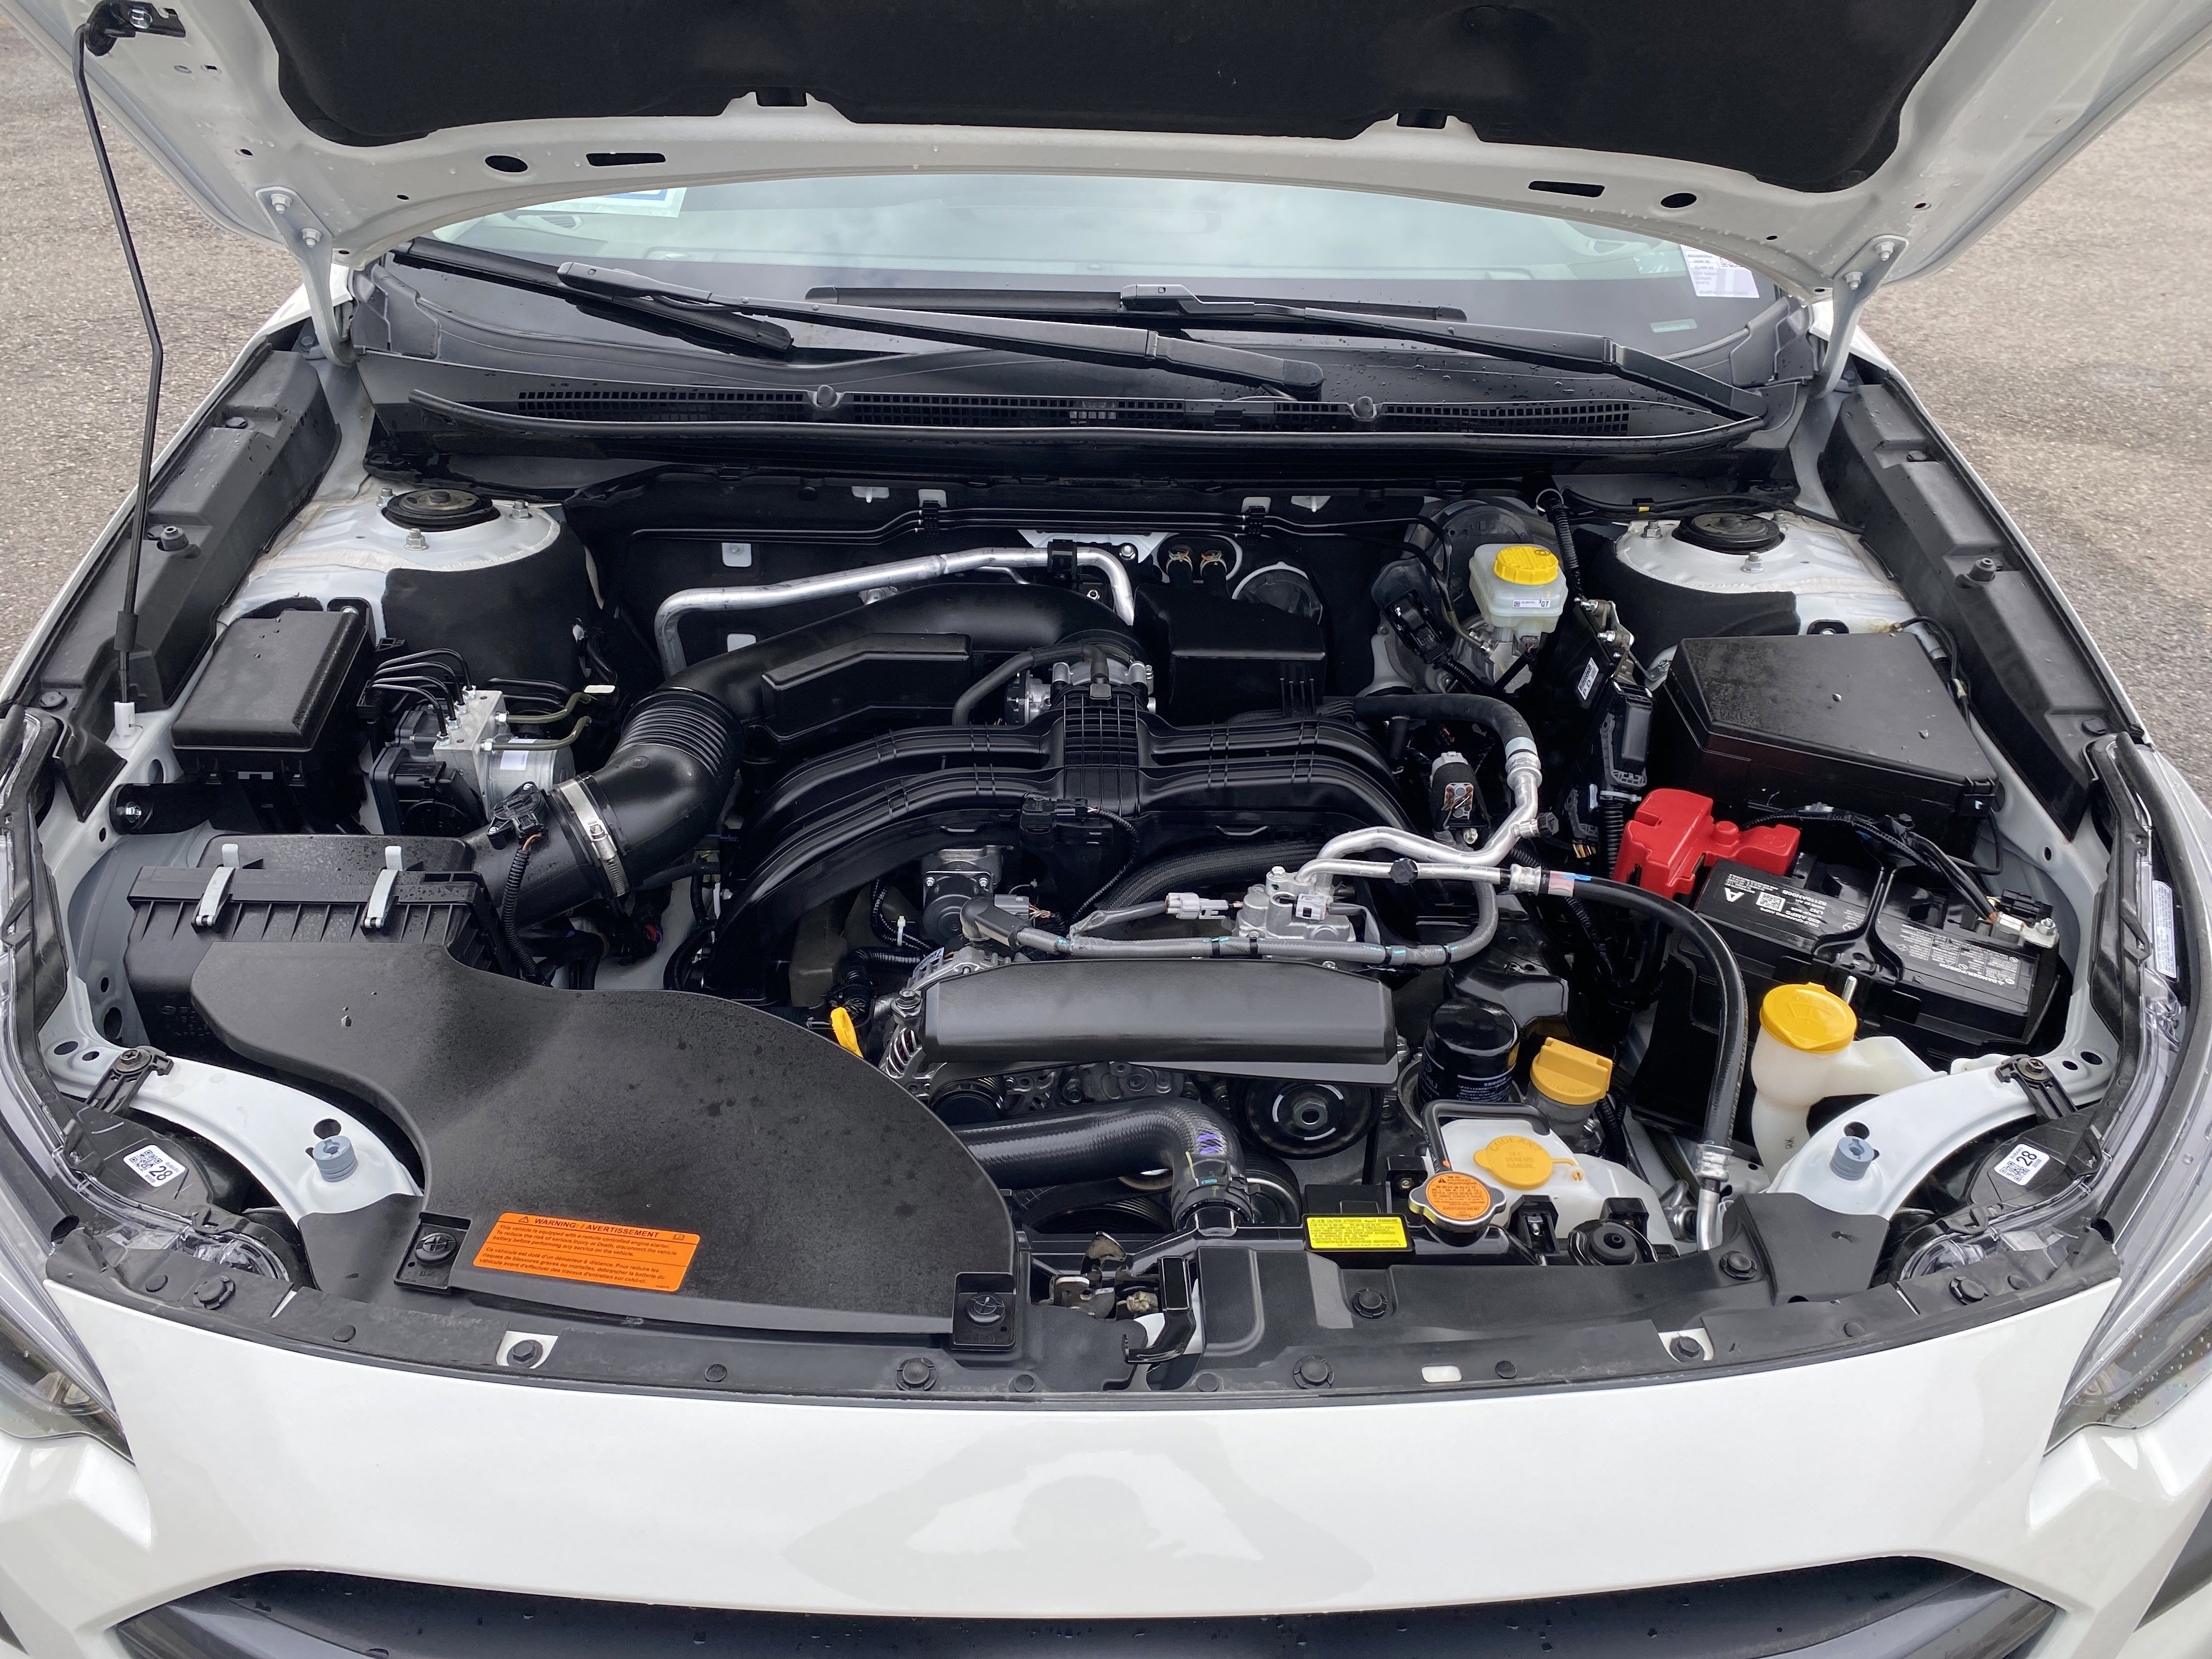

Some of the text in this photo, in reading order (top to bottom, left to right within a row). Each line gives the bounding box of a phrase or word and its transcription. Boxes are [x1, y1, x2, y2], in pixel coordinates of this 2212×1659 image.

[1725, 887, 1745, 902] A
[1782, 889, 1827, 906] 82110AN00B
[1775, 912, 1804, 923] CRANKING
[1785, 910, 1807, 919] AMPS
[1803, 911, 1822, 919] GROUP
[1939, 962, 1997, 984] DANGER/POISON
[1490, 1137, 1543, 1152] COOLANT
[2016, 1150, 2037, 1166] 28
[149, 1166, 173, 1181] 28
[586, 1224, 659, 1238] AVERTISSEMENT
[531, 1240, 562, 1249] performing
